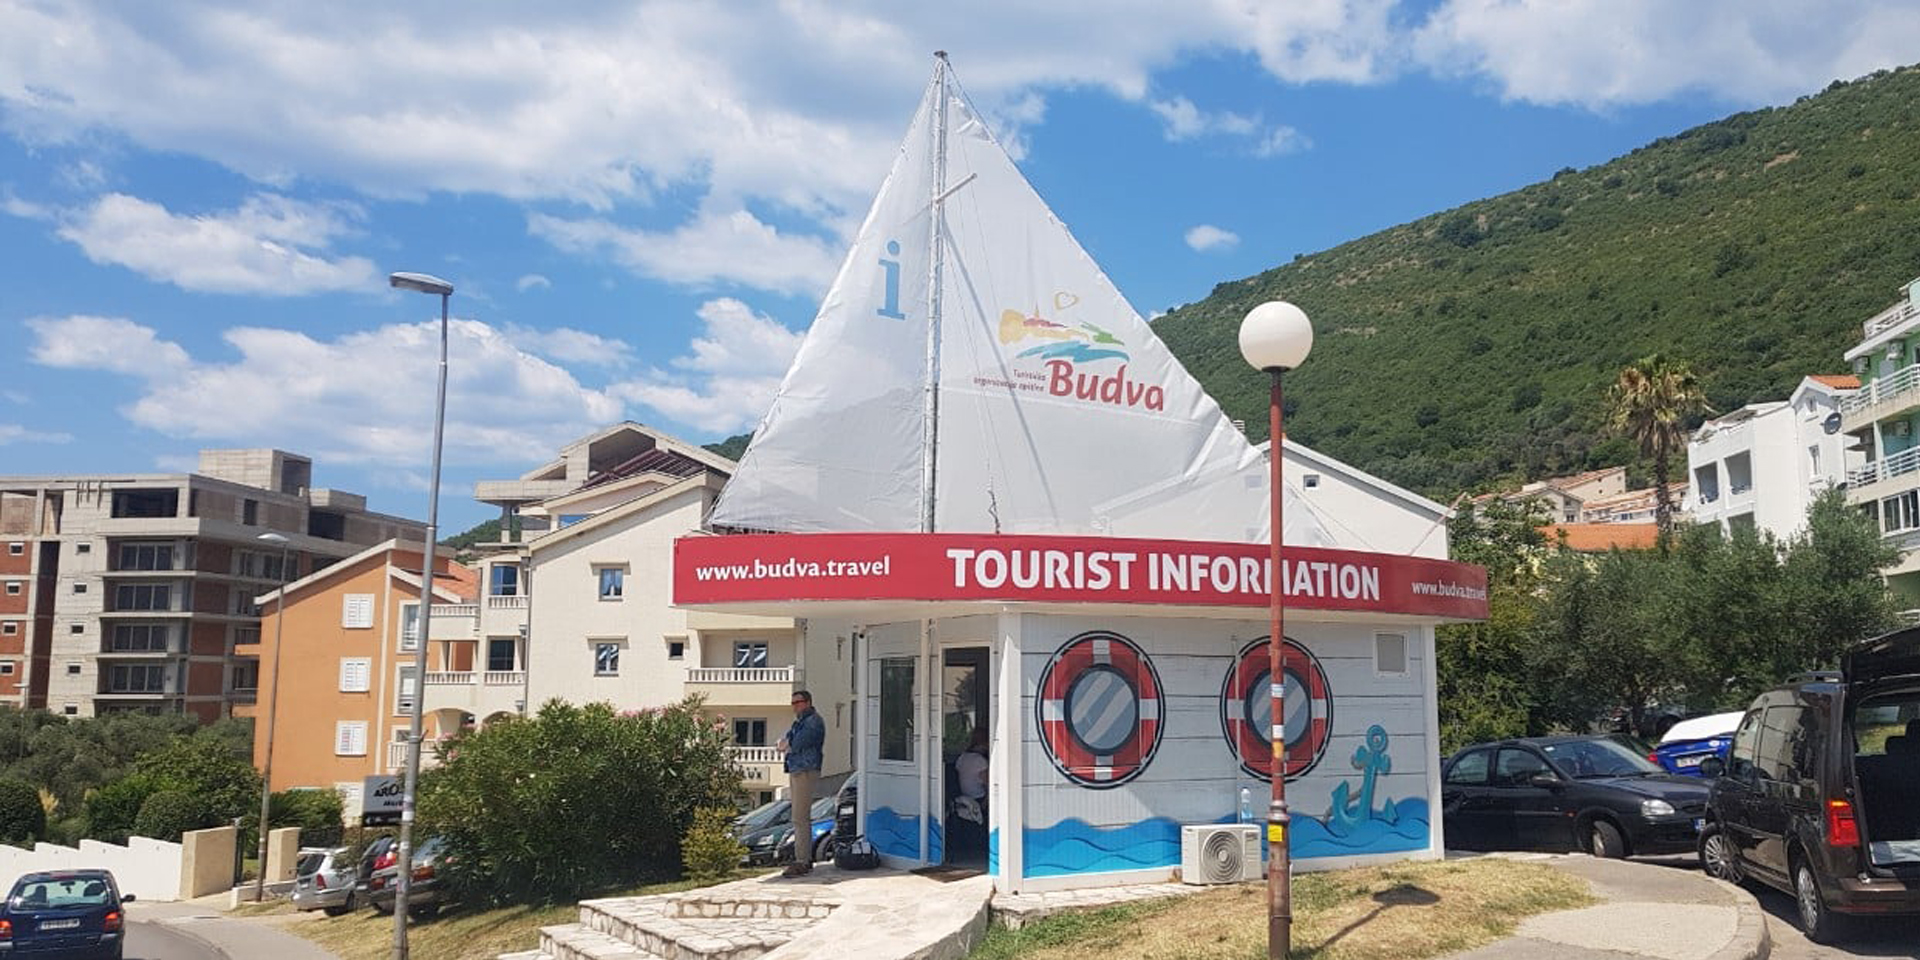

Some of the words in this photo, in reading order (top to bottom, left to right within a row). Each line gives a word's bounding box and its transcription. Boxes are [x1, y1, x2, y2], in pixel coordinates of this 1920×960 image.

[1045, 359, 1163, 411] Budva
[696, 555, 890, 581] www.budva.travel
[946, 549, 1137, 590] TOURIST
